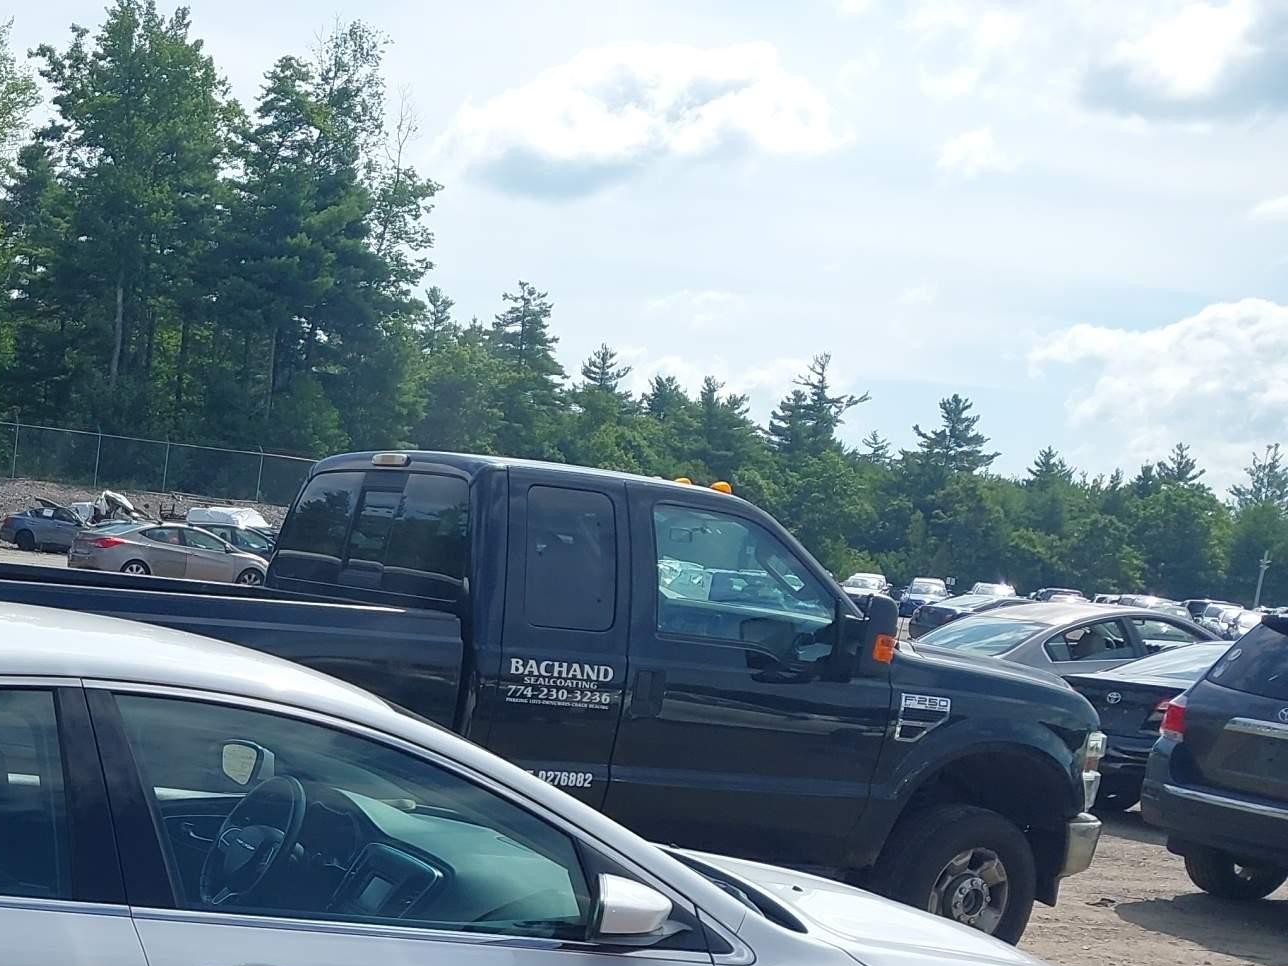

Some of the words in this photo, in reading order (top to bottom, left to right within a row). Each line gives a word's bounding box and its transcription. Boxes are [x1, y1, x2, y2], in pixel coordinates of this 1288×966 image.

[510, 658, 614, 682] BACHAND
[523, 676, 598, 690] SEALCOATING
[507, 685, 611, 704] 774-230-3236
